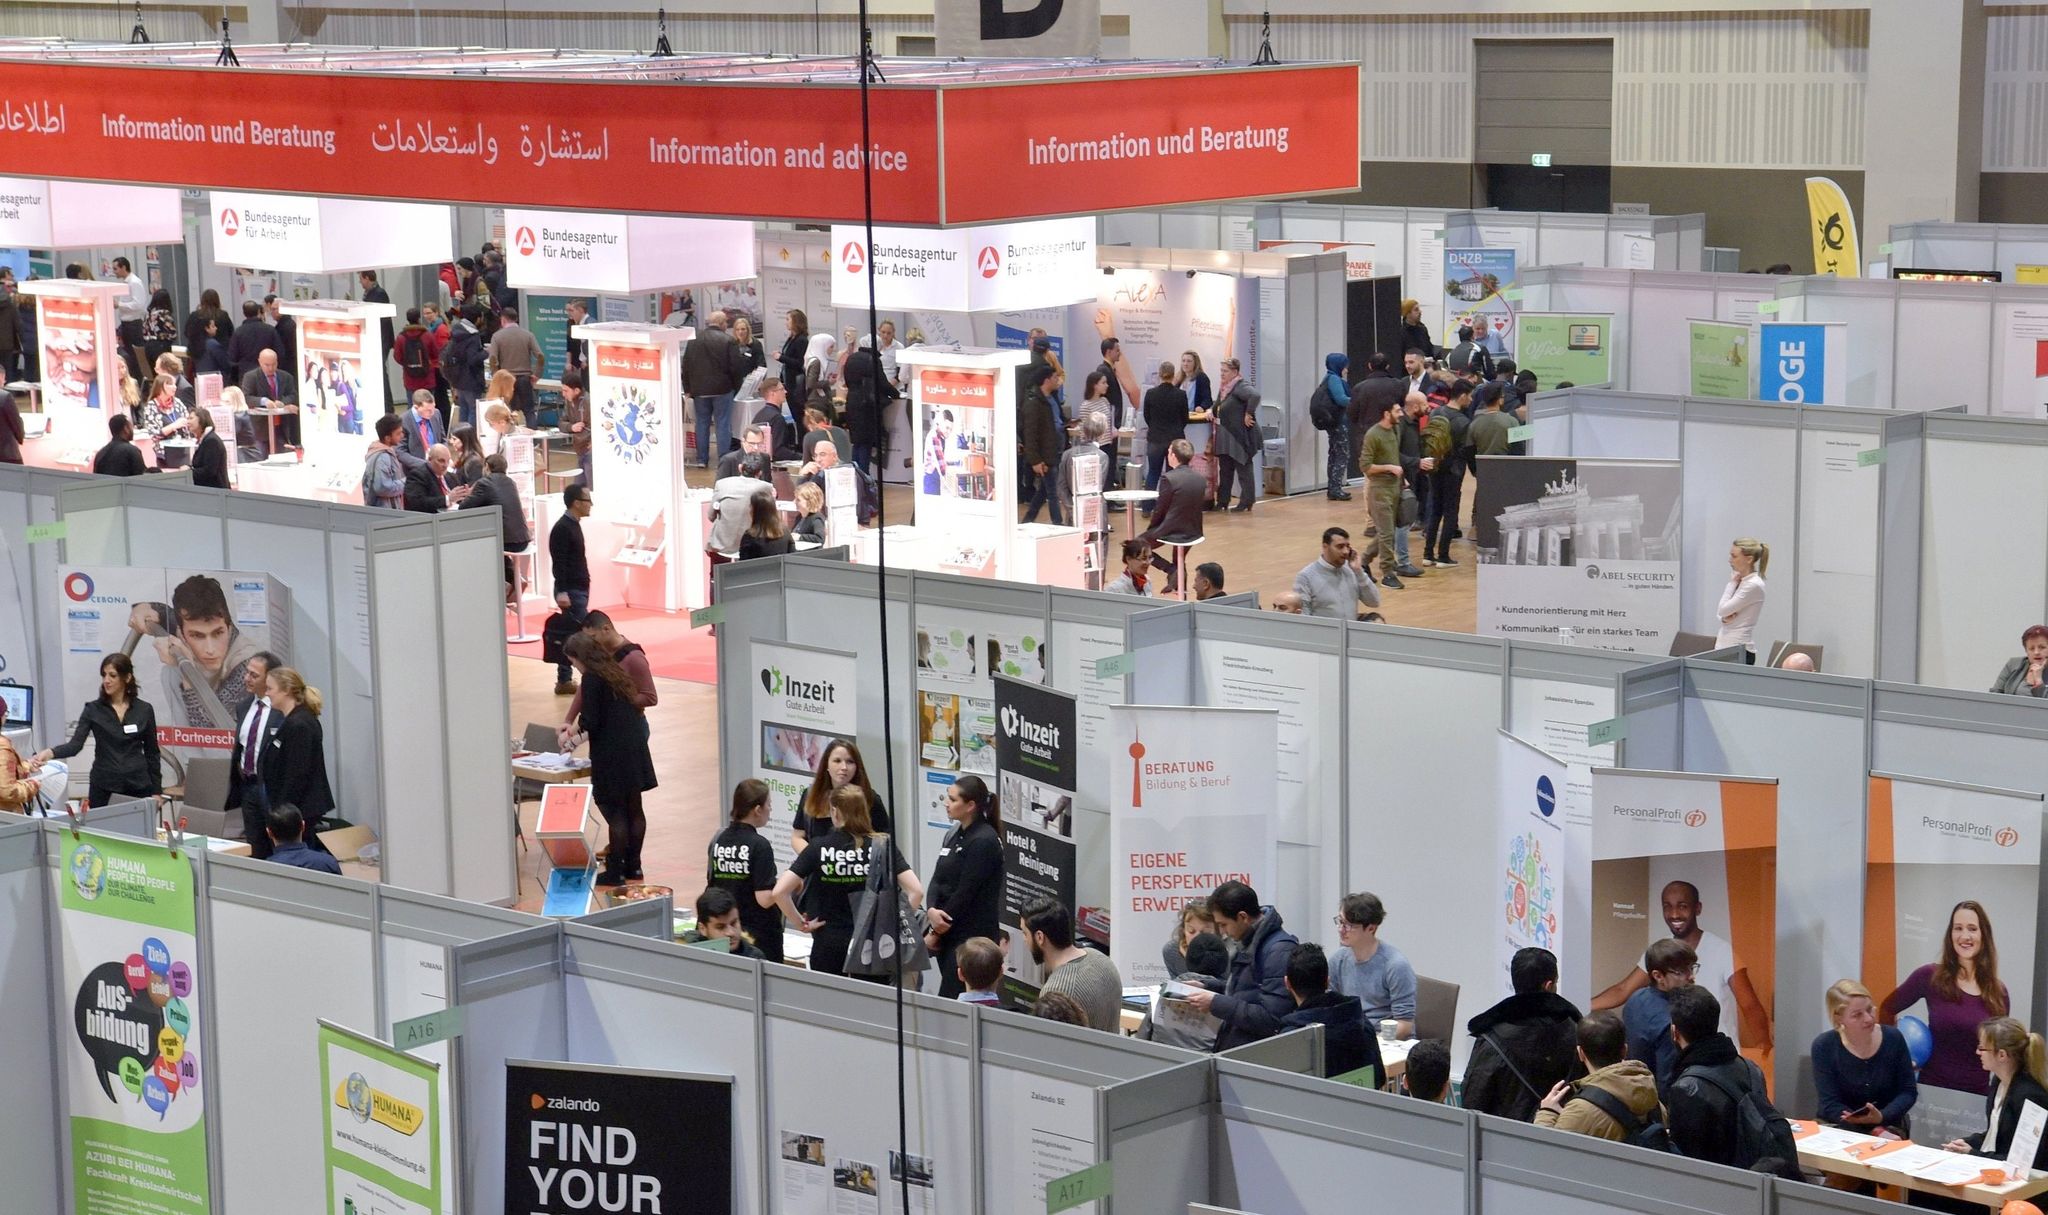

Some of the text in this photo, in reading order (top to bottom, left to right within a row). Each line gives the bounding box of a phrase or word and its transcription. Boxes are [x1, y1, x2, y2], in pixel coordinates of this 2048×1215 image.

[0, 99, 65, 136] اطلاعا
[102, 113, 336, 154] Information und Beratung
[371, 119, 609, 167] استشارة واستعلامات
[1028, 124, 1289, 165] Information und Beratung
[650, 137, 777, 167] Information
[784, 142, 826, 169] and
[0, 193, 41, 209] esagentur
[0, 207, 20, 220] rbeit
[244, 210, 312, 227] Bundesagentur
[245, 226, 288, 241] für Arbeit
[542, 227, 619, 245] Bundesagentur
[543, 245, 591, 261] für Arbeit
[873, 242, 959, 262] Bundesagentur
[1448, 252, 1483, 264] DHZB
[873, 261, 926, 279] für Arbeit
[1600, 571, 1676, 582] ABEL SECURITY
[1501, 605, 1627, 618] Kundenorientierung mit Herz
[1501, 623, 1560, 634] Kommunikati
[1586, 626, 1601, 635] ein
[1602, 626, 1633, 637] starkes
[1634, 628, 1659, 638] Team
[785, 674, 835, 704] Inzeit
[785, 699, 826, 716] Gute Arbeit
[156, 728, 235, 745] rt. Partnersch
[1020, 715, 1060, 750] Inzeit
[1020, 741, 1053, 761] Gute Arbeit
[1145, 760, 1214, 775] BERATUNG
[763, 777, 798, 797] Pflege
[1146, 776, 1232, 791] Bildung & Beruf
[1613, 804, 1682, 819] PersonalProfi
[1922, 815, 1993, 837] PersonalProfi
[1006, 829, 1037, 853] Hotel &
[737, 844, 750, 861] &
[820, 845, 864, 862] Meet
[1130, 852, 1188, 869] EIGENE
[107, 856, 146, 875] HUMANA
[717, 858, 750, 875] Greet
[835, 860, 870, 876] Gree
[1018, 851, 1060, 882] Reinigung
[107, 871, 176, 892] PEOPLE TO PEOPLE
[1132, 895, 1207, 912] ERWEIT
[419, 960, 443, 972] HUMANA
[1143, 962, 1168, 971] offene
[97, 980, 133, 1012] Aus-
[86, 1008, 150, 1056] bildung
[407, 1021, 435, 1043] A16
[182, 1060, 194, 1078] Job
[547, 1096, 600, 1112] zalando
[1031, 1092, 1066, 1106] Zalando SE
[372, 1095, 413, 1124] HUMANA
[335, 1129, 427, 1175] www.humana-kleidersammlung.de
[530, 1120, 637, 1166] FIND
[86, 1150, 176, 1181] AZUBI BEI HUMANA:
[86, 1166, 129, 1184] Fachkraft
[129, 1175, 203, 1206] Kreislaufwirtschaft
[528, 1165, 662, 1215] YOUR
[1059, 1180, 1084, 1203] A17
